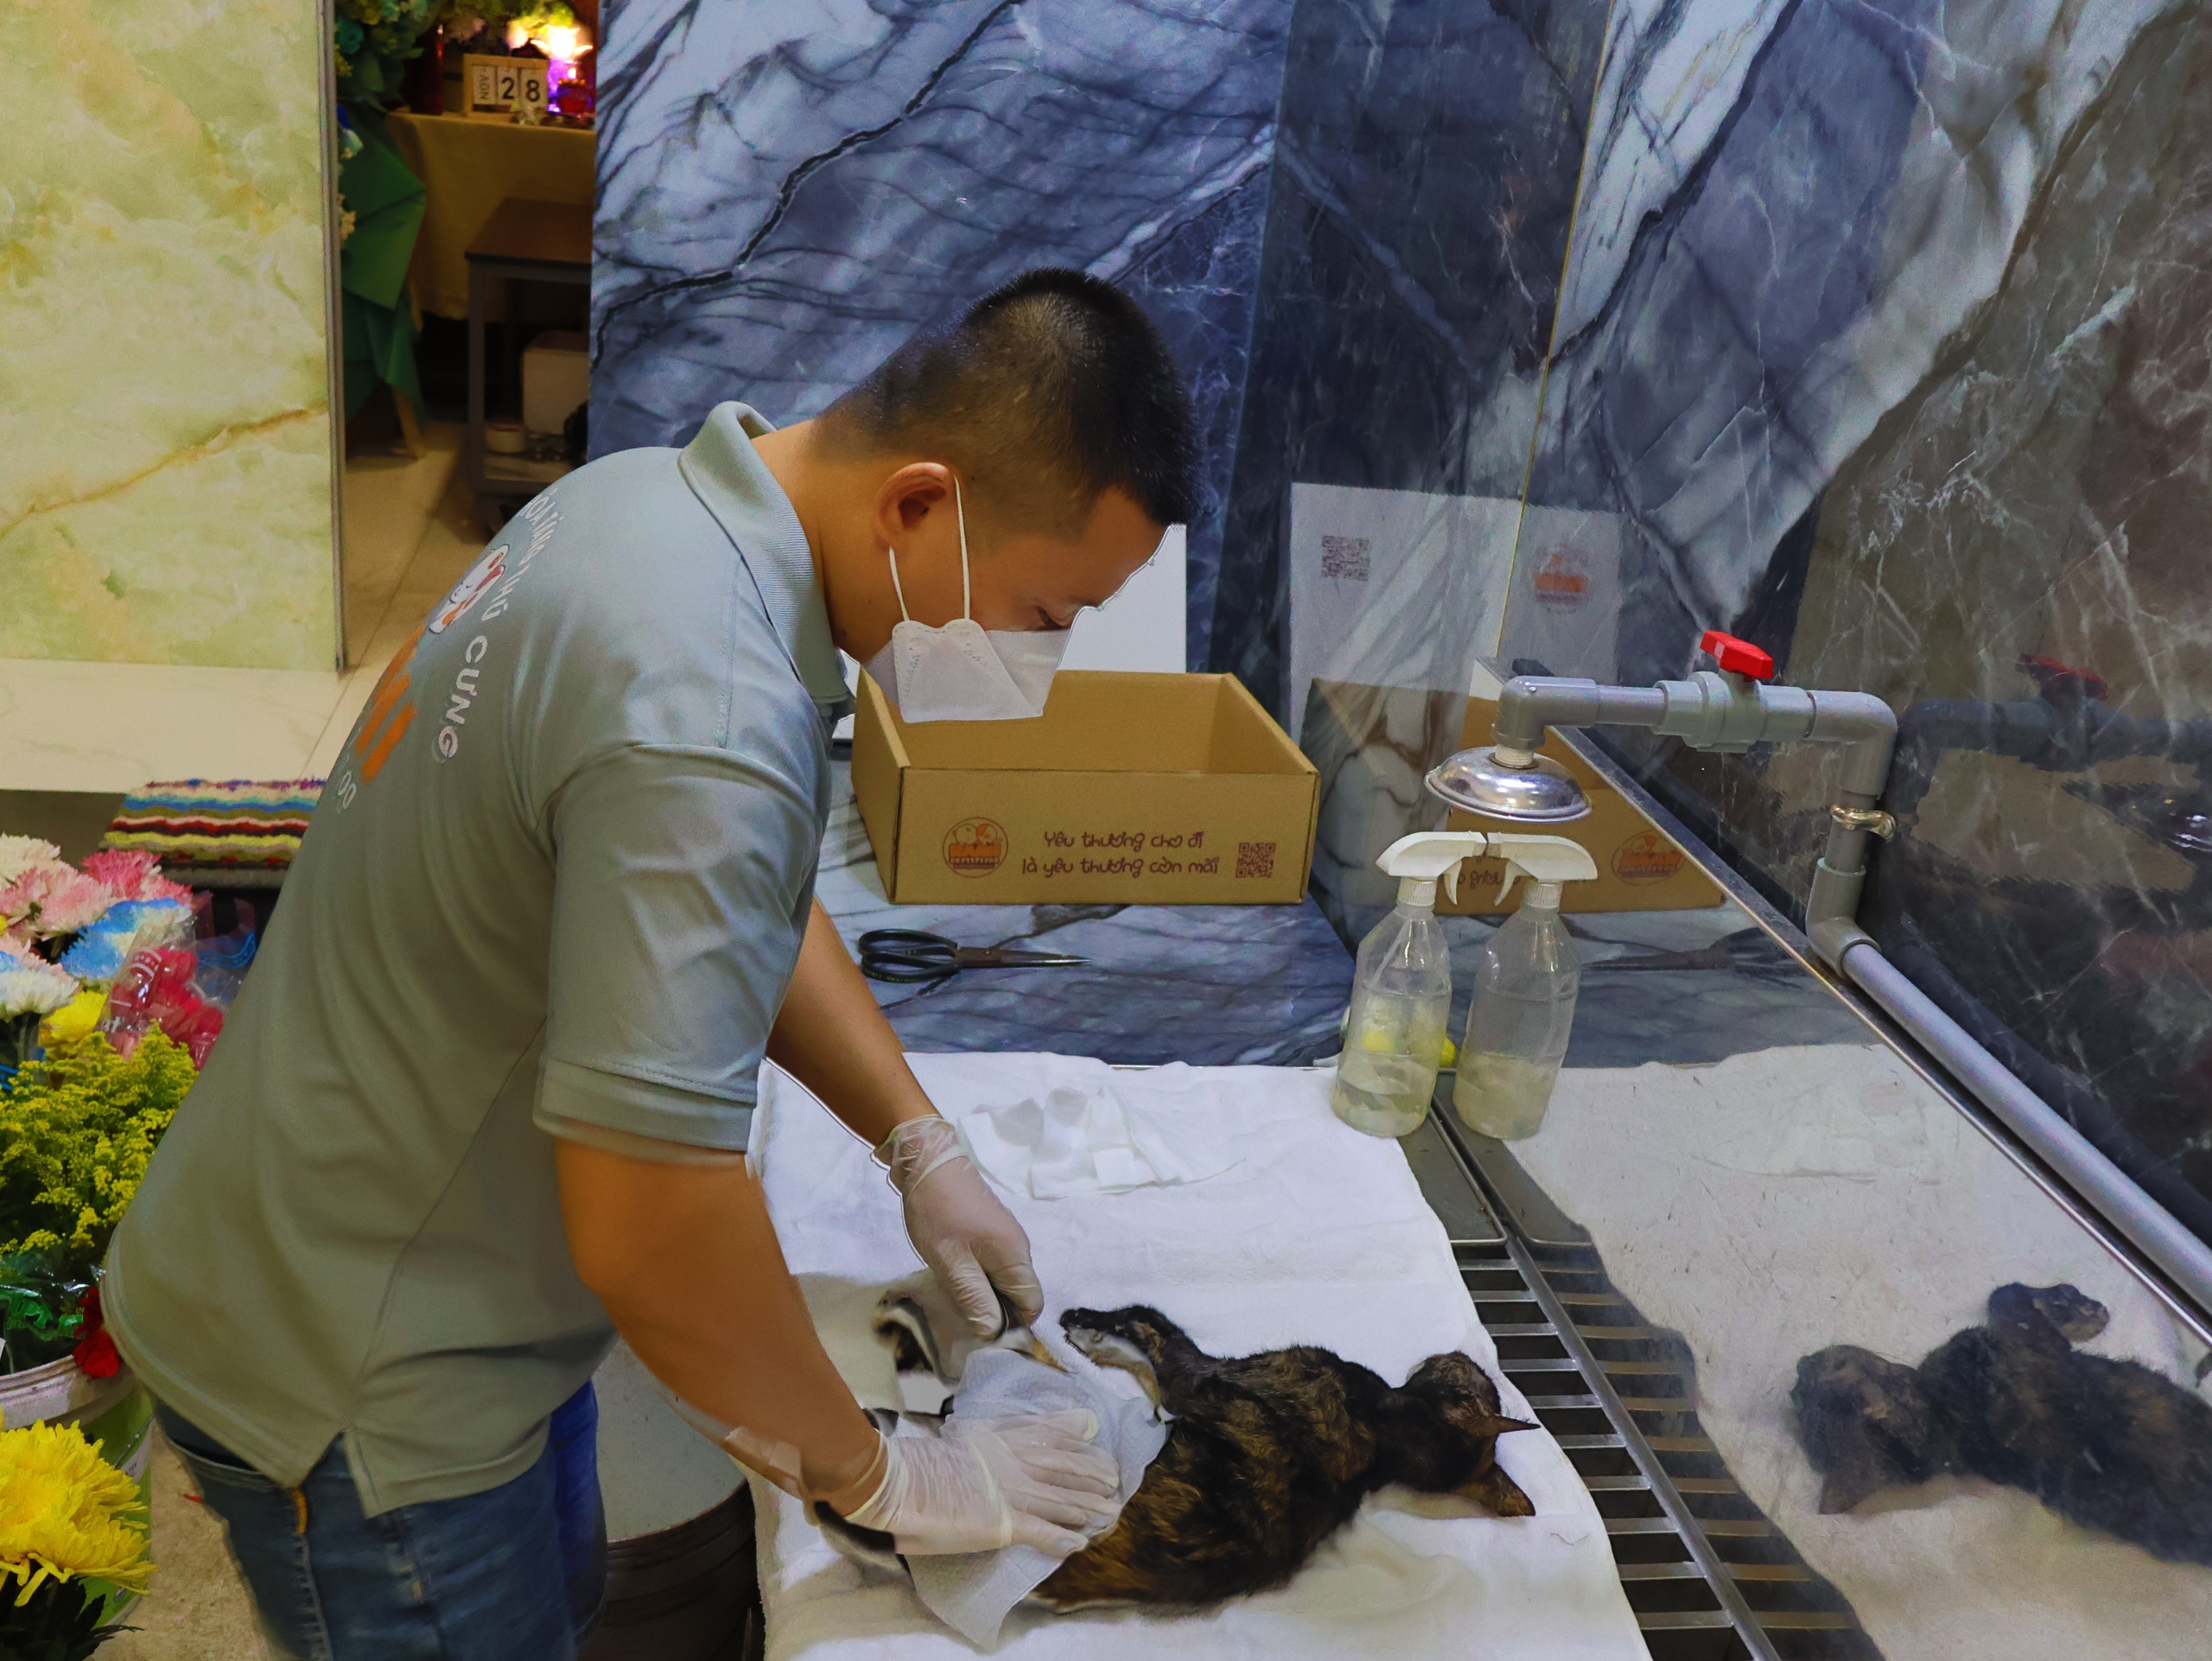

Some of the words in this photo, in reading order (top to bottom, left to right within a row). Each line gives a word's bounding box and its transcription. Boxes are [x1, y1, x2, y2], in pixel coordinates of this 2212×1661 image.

[501, 77, 541, 103] 28
[438, 635, 488, 758] CƯNG
[1044, 831, 1075, 847] Yêu
[1081, 830, 1145, 853] thương
[1151, 834, 1183, 848] cho
[1187, 830, 1205, 849] đi
[1021, 856, 1038, 874] là
[1043, 857, 1073, 878] yêu
[1079, 857, 1144, 879] thương
[1149, 856, 1183, 874] còn
[1188, 857, 1220, 874] mãi
